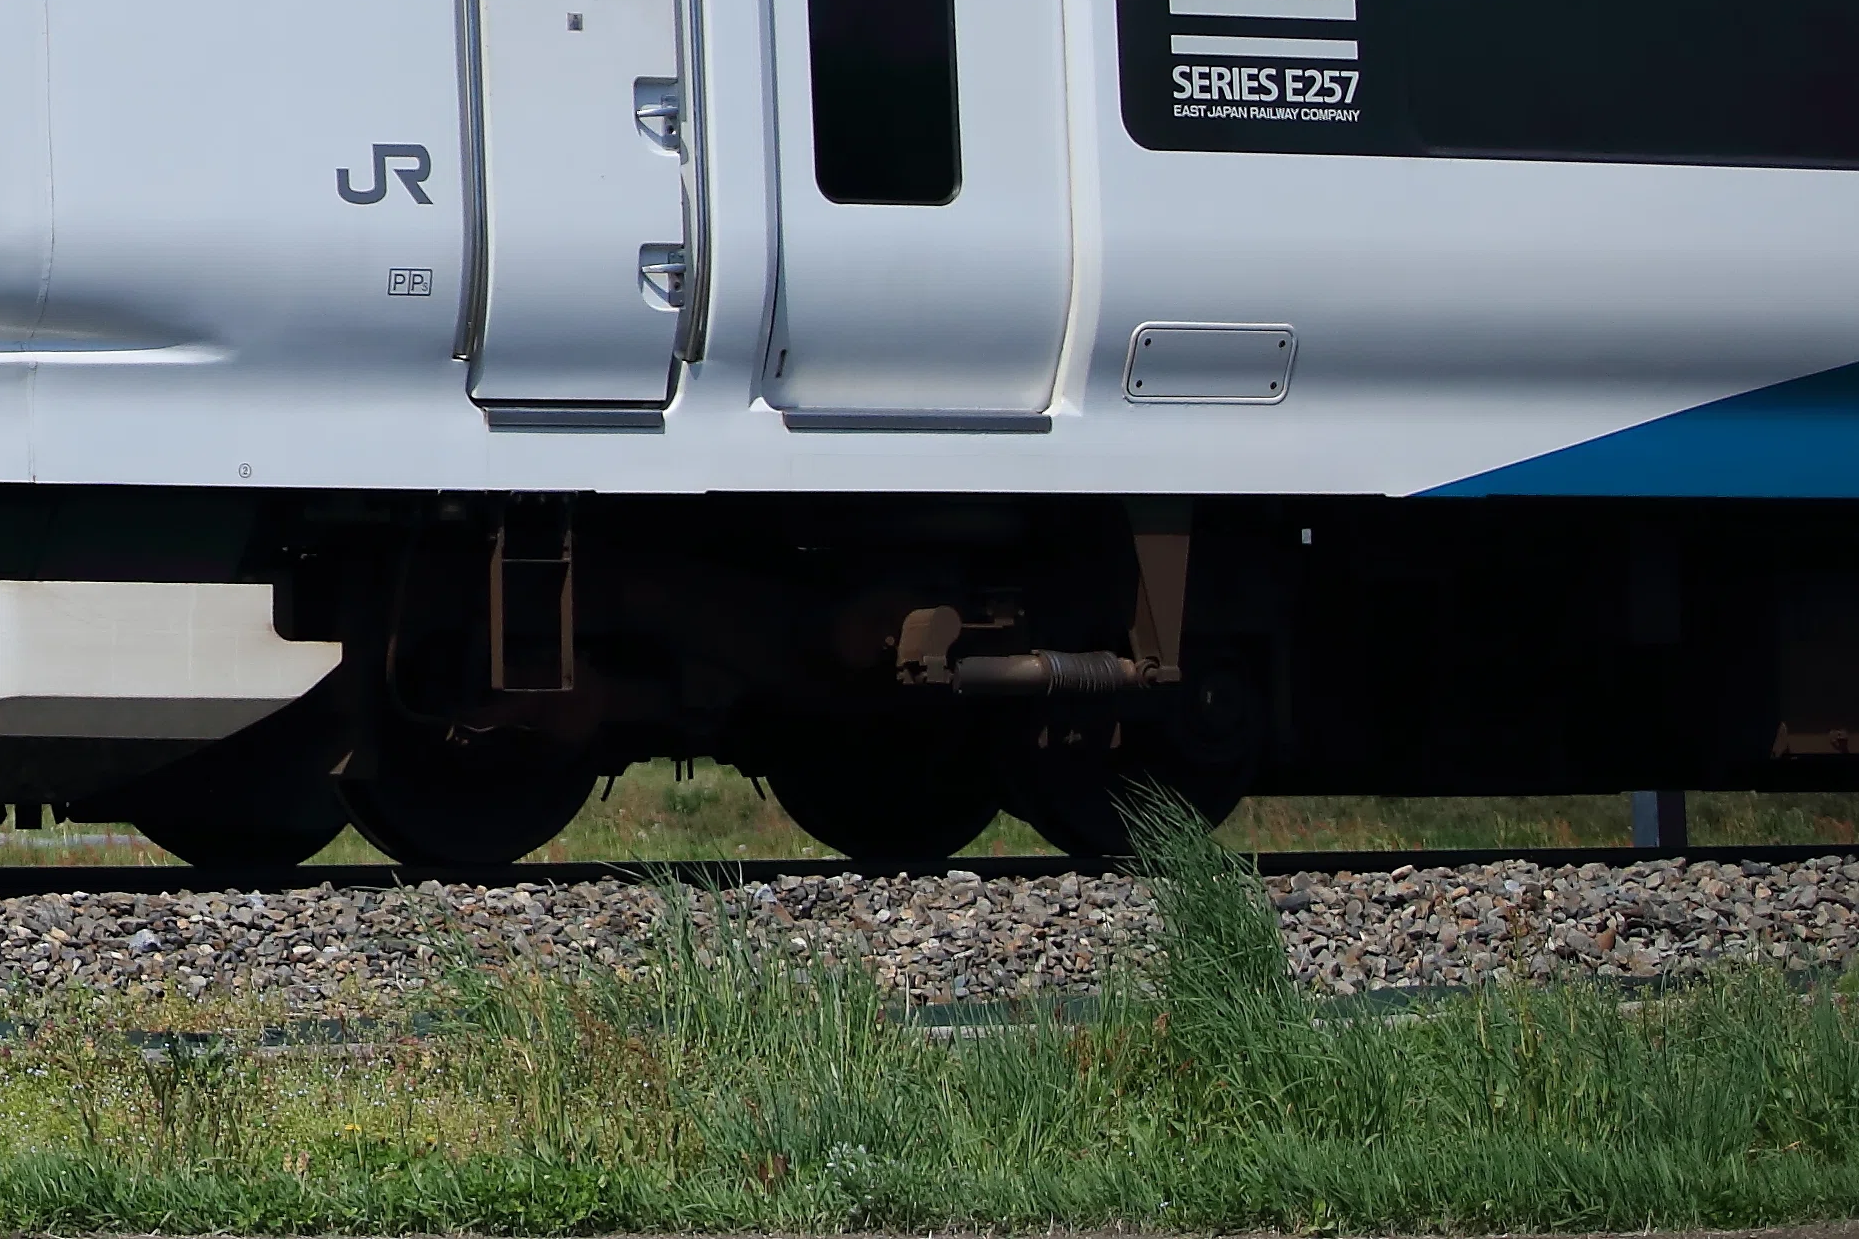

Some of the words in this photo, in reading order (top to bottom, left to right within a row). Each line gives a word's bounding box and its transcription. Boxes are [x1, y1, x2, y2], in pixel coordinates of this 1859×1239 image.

[1172, 65, 1278, 102] SERIES
[1285, 68, 1359, 104] E257
[1173, 104, 1206, 117] EAST
[1207, 105, 1247, 119] JAPAN
[1250, 107, 1299, 120] RAILWAY
[1301, 108, 1361, 122] COMPANY
[336, 144, 433, 204] JR
